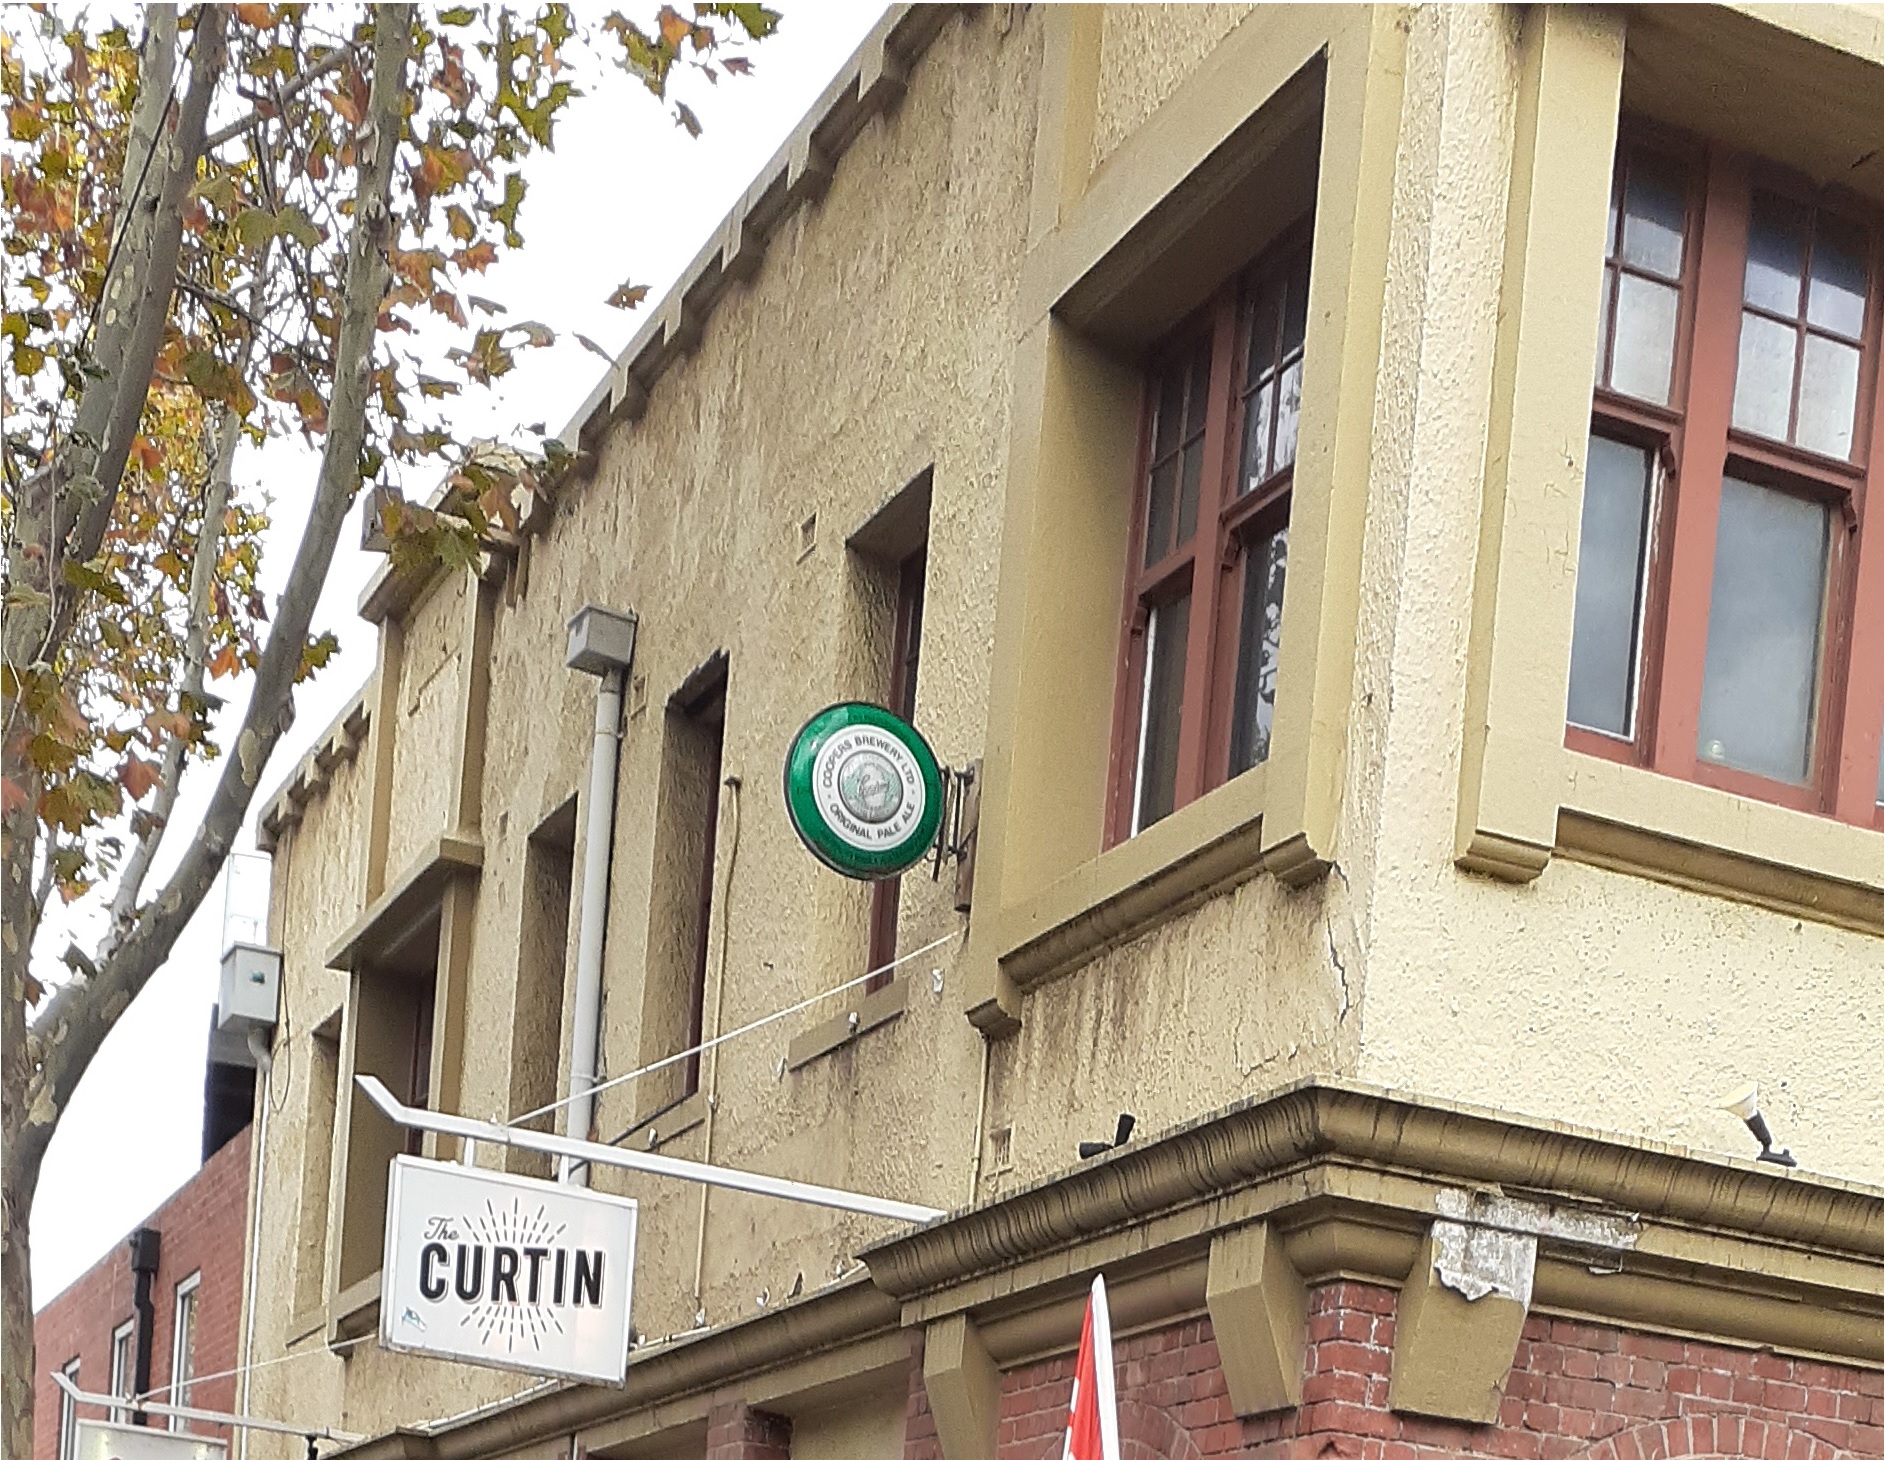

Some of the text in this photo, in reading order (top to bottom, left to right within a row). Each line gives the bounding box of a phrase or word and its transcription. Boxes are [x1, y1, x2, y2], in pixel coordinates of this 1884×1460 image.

[822, 735, 915, 788] COOPERS BREWERY LTD
[829, 802, 916, 840] ORIGINAL PALE ALE
[423, 1216, 460, 1241] The
[419, 1242, 607, 1308] CURTIN
